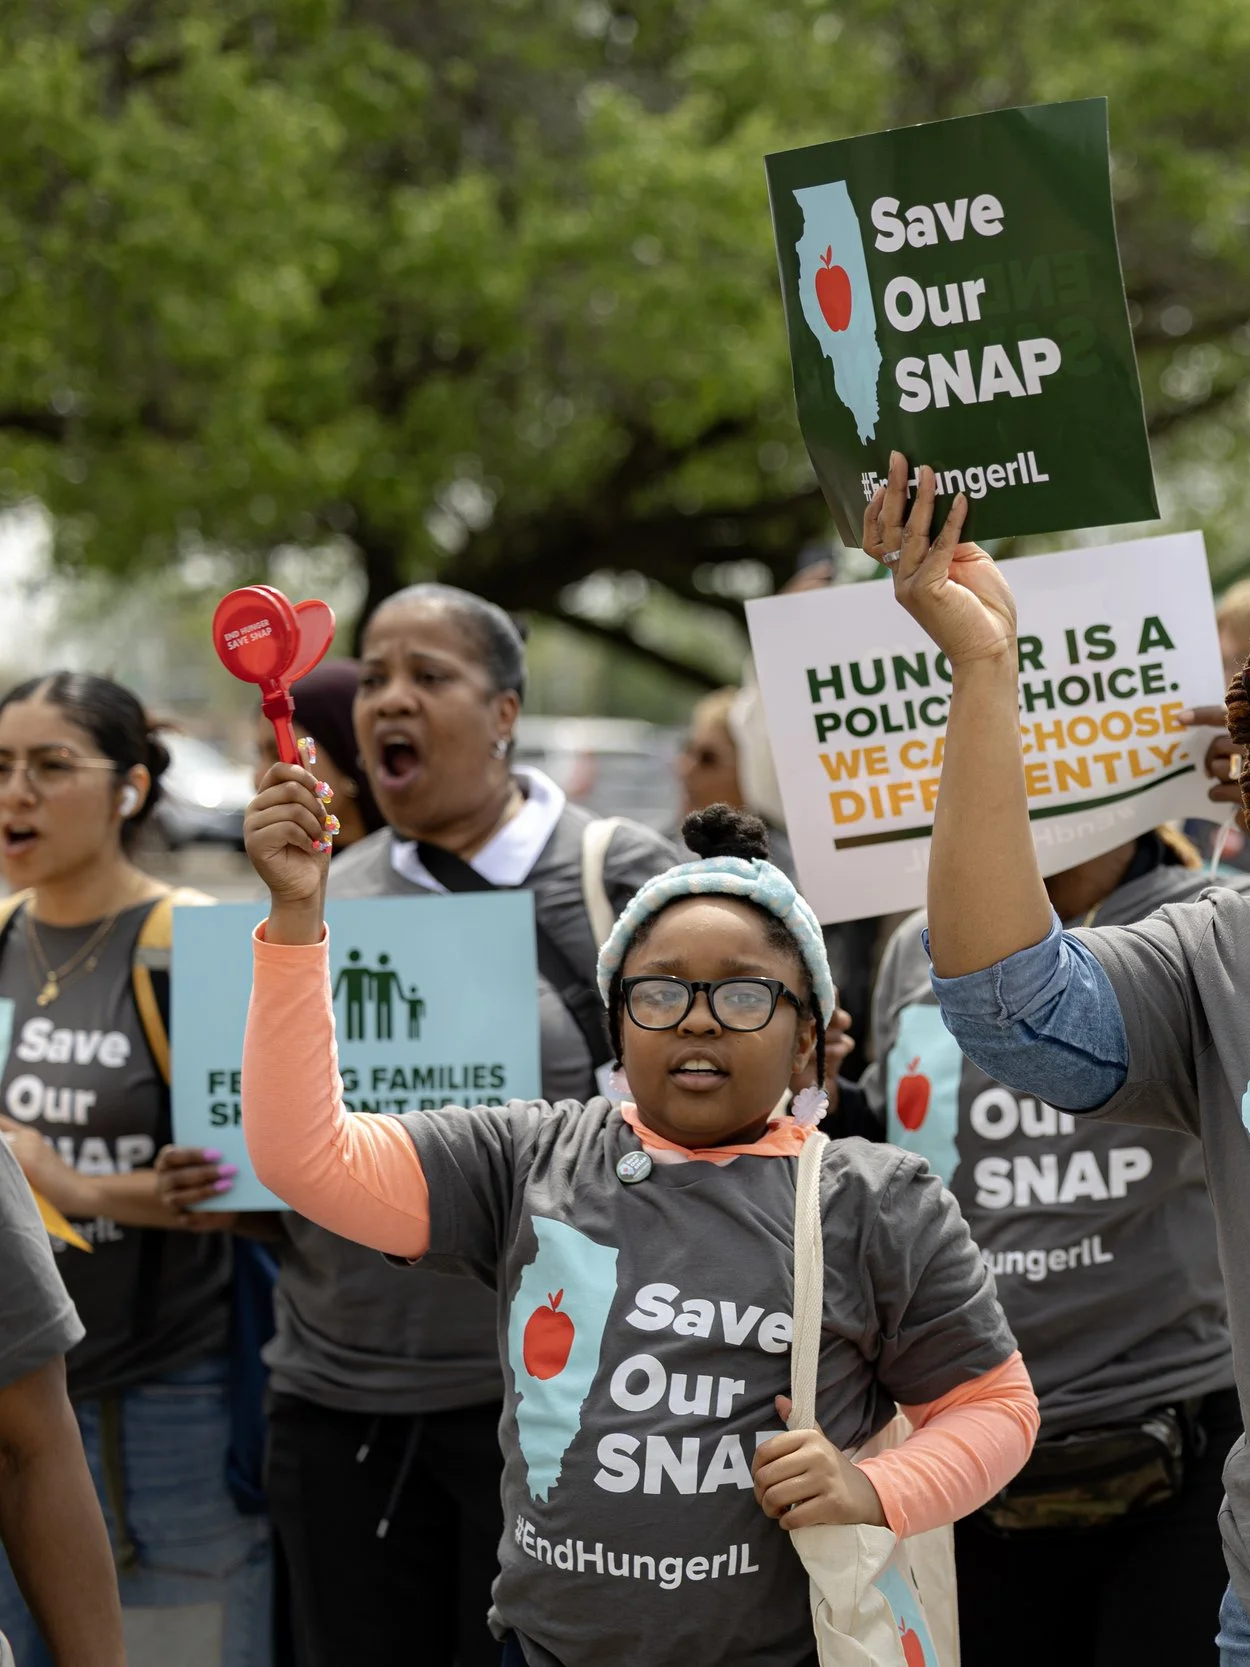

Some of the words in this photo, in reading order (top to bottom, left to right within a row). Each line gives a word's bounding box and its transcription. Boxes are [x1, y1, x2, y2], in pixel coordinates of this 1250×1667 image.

[870, 194, 1004, 253] Save
[884, 275, 986, 332] Our
[895, 337, 1061, 413] SNAP
[861, 451, 1050, 502] #EHungerIL
[224, 630, 240, 642] END
[227, 636, 249, 650] SAVE
[250, 627, 272, 642] SNAP
[806, 634, 1046, 703] HUNR
[1065, 624, 1116, 666] IS
[1138, 616, 1175, 655] A
[814, 696, 952, 743] POLIC
[1018, 662, 1179, 713] HOICE.
[819, 745, 891, 782] WE
[829, 741, 1190, 825] DIFFENTLY.
[16, 1016, 131, 1068] Save
[6, 1073, 97, 1125] Our
[371, 1064, 506, 1092] FAMILIES
[44, 1133, 155, 1176] AP
[973, 1147, 1153, 1210] SNAP
[625, 1283, 793, 1354] Save
[609, 1354, 745, 1418] Our
[594, 1430, 786, 1495] SNA
[514, 1513, 759, 1590] #EndHungerIL
